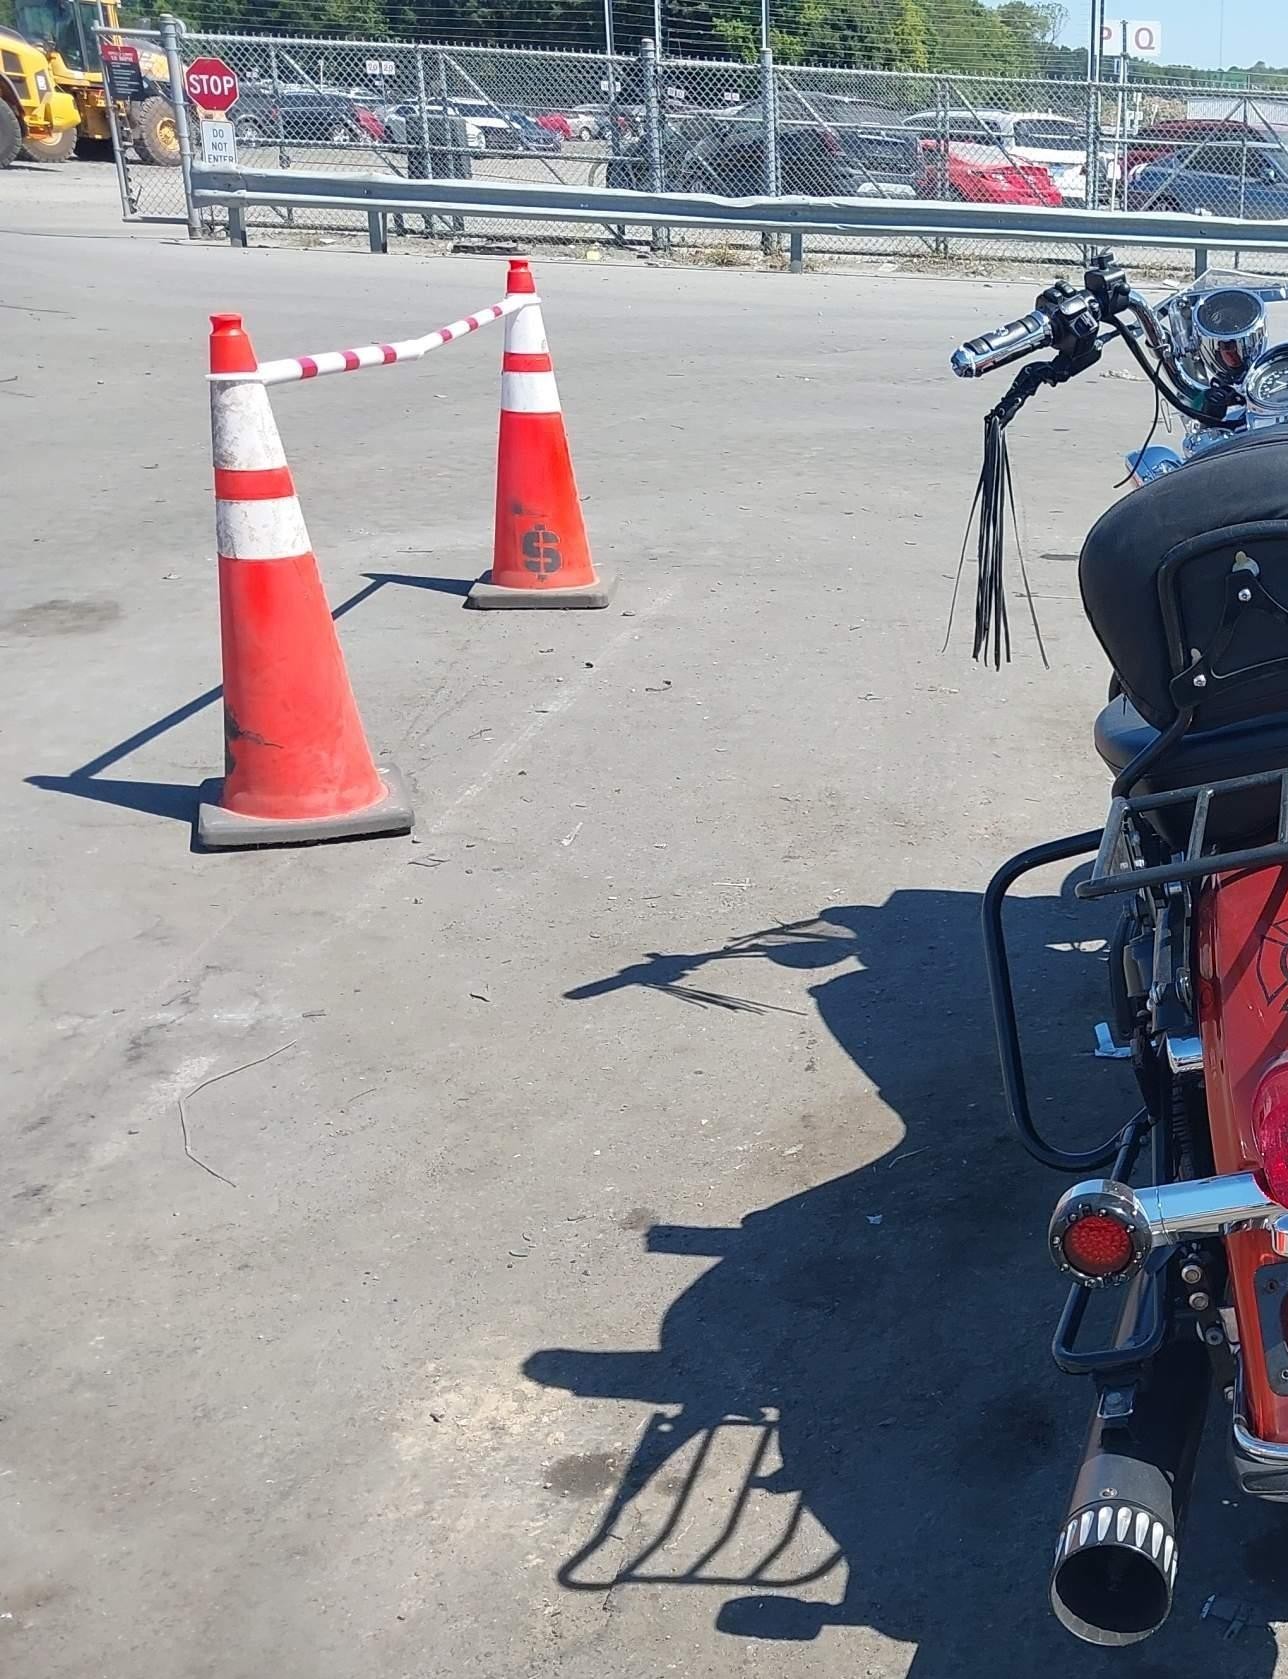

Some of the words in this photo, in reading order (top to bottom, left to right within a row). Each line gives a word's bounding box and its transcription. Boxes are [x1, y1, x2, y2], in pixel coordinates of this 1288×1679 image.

[1135, 27, 1155, 50] Q
[189, 74, 234, 95] STOP
[212, 129, 224, 138] DO
[211, 142, 228, 152] NOT
[208, 154, 234, 164] ENTER
